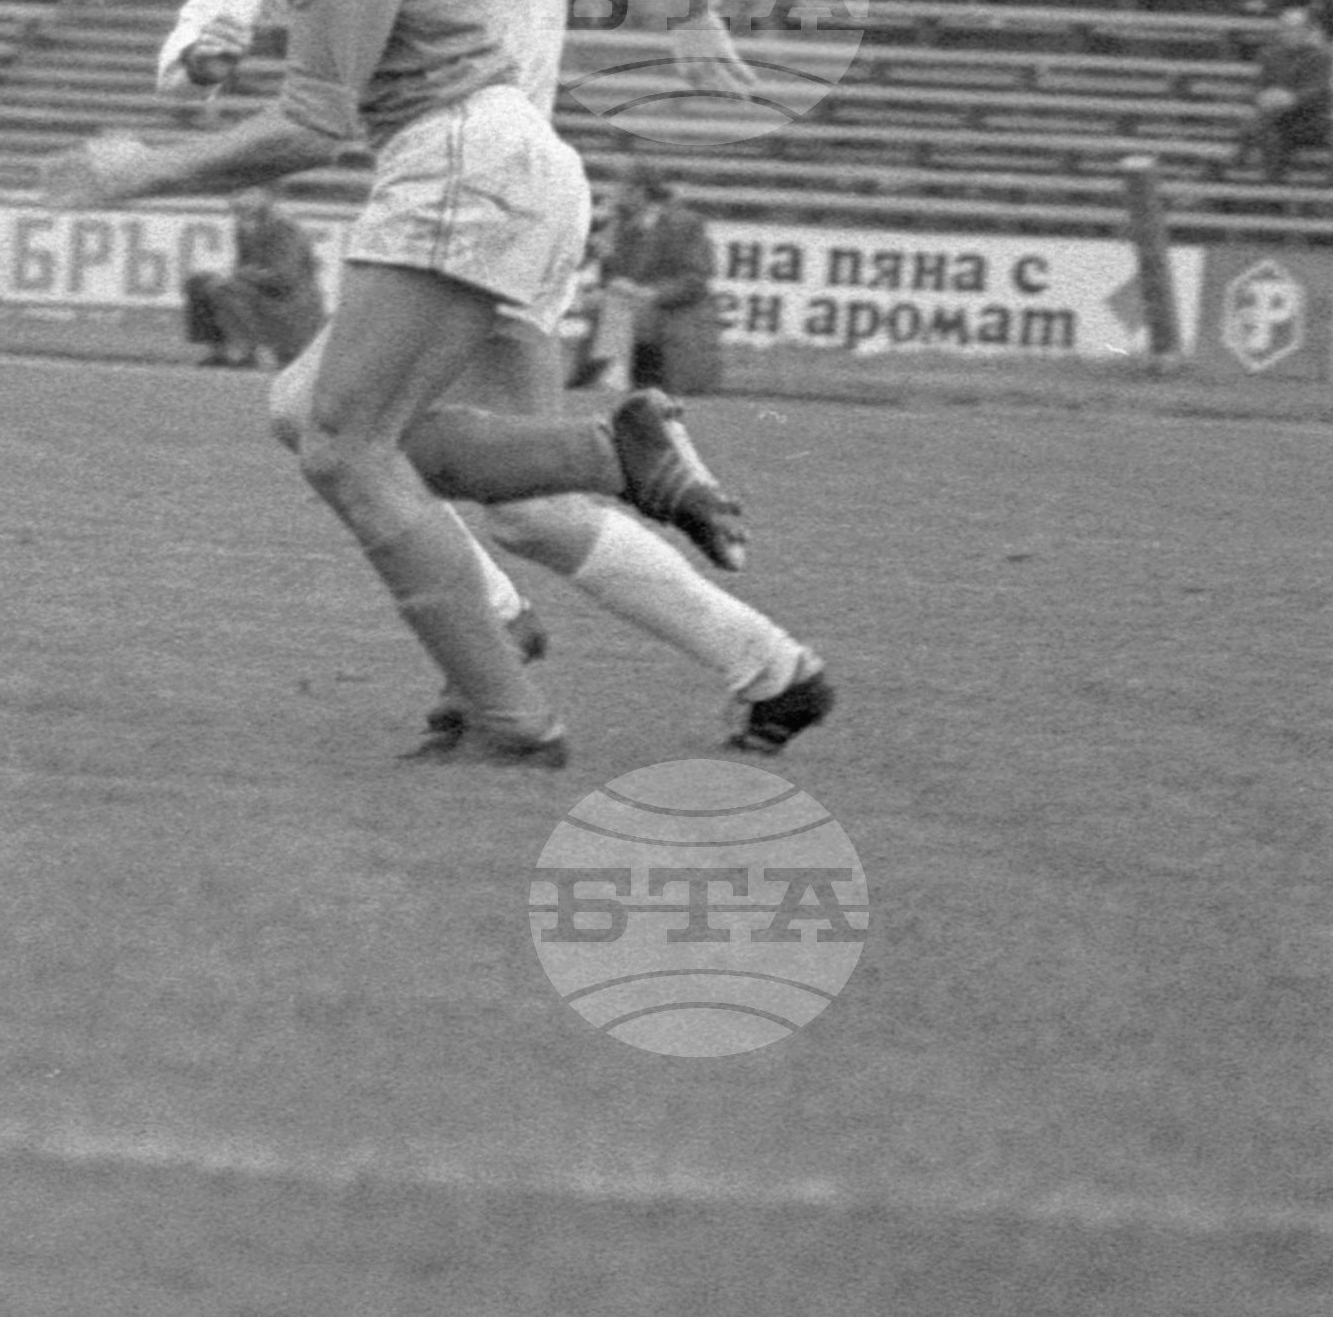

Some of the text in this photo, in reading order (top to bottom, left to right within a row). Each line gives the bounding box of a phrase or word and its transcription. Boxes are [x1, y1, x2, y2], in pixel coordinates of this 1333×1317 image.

[828, 247, 987, 293] пяна
[711, 293, 1076, 349] ен аромат
